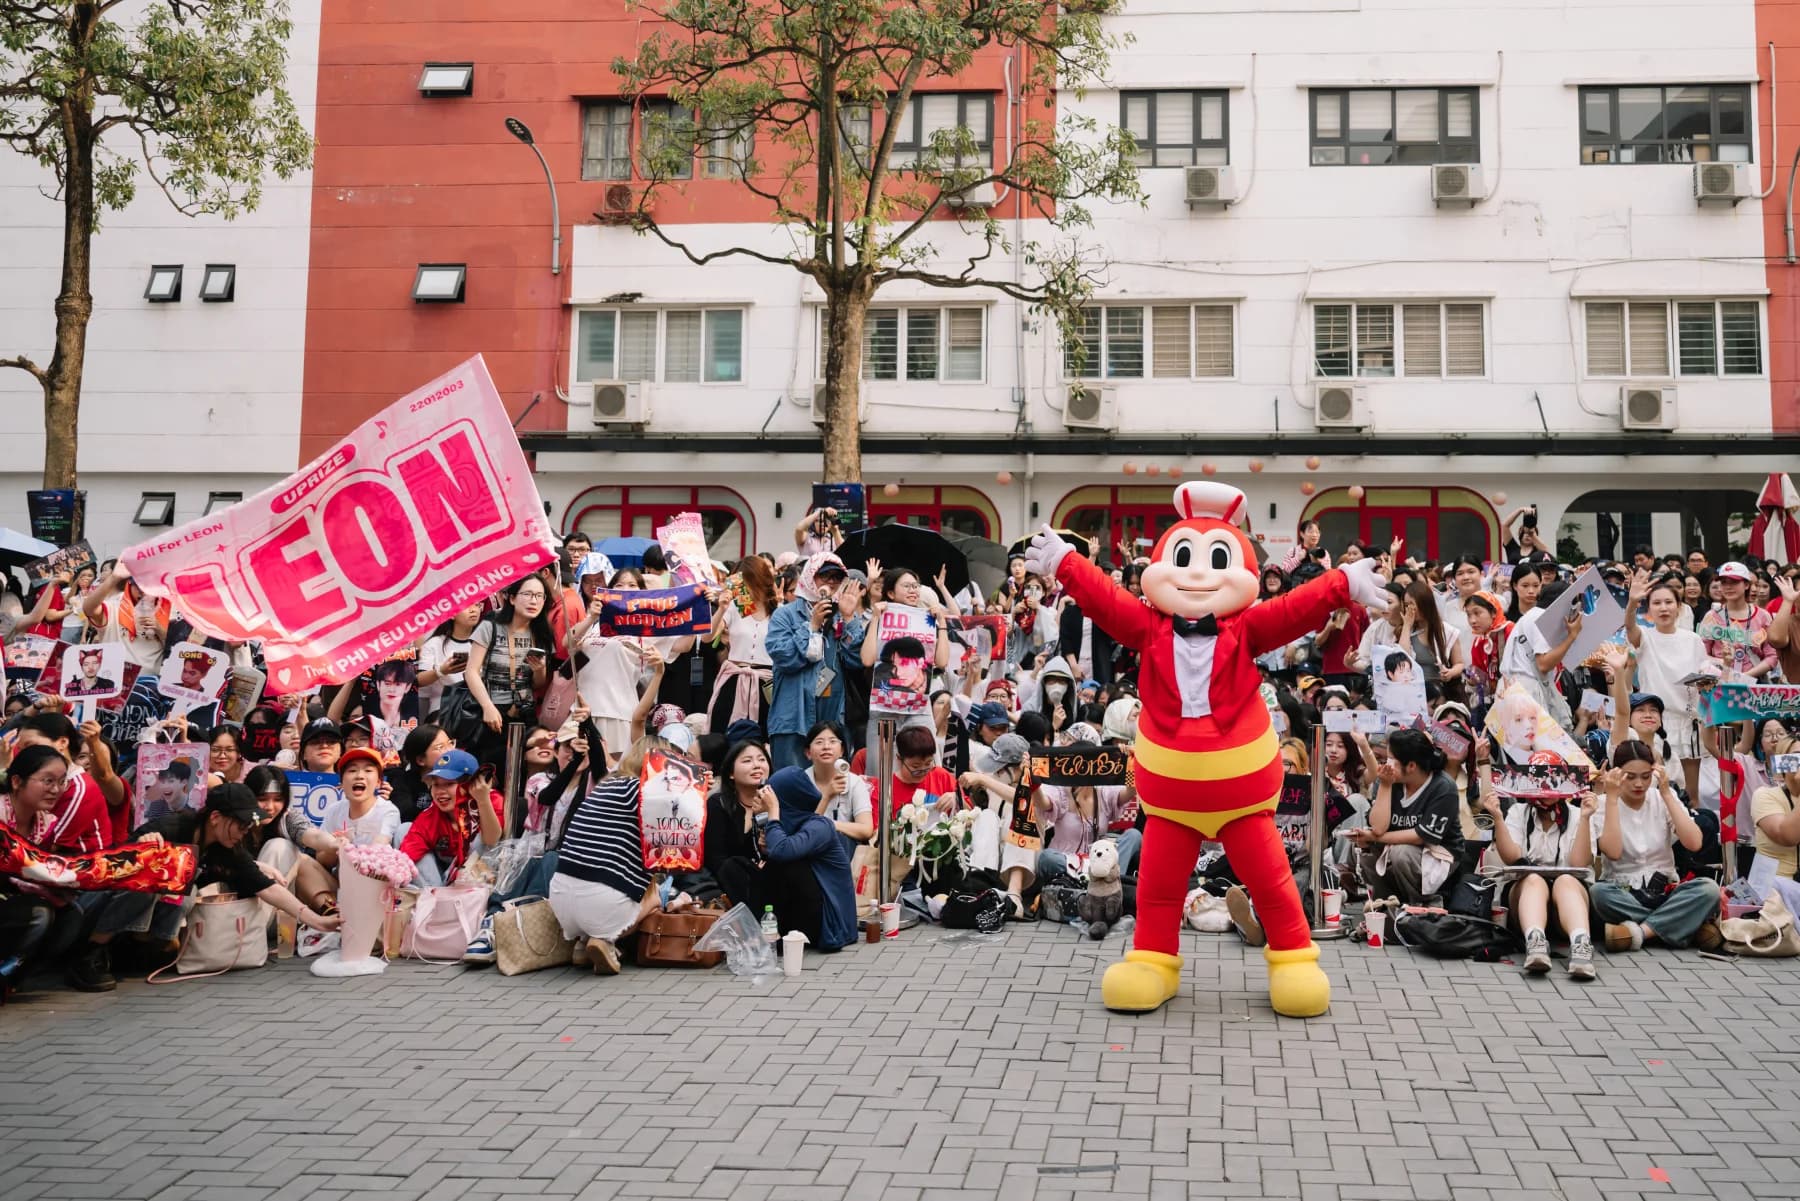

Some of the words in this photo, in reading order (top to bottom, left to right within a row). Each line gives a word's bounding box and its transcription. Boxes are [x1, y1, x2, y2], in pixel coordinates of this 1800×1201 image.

[410, 379, 464, 413] 22012003
[282, 452, 346, 505] UPRIZE
[136, 547, 156, 561] All
[158, 539, 182, 553] For
[184, 522, 224, 542] LEON
[174, 430, 502, 637] LEON
[336, 647, 369, 673] PHI
[366, 626, 404, 654] YÊU
[405, 599, 453, 632] LONG
[451, 565, 515, 604] HOÀNG
[1426, 803, 1449, 834] 13
